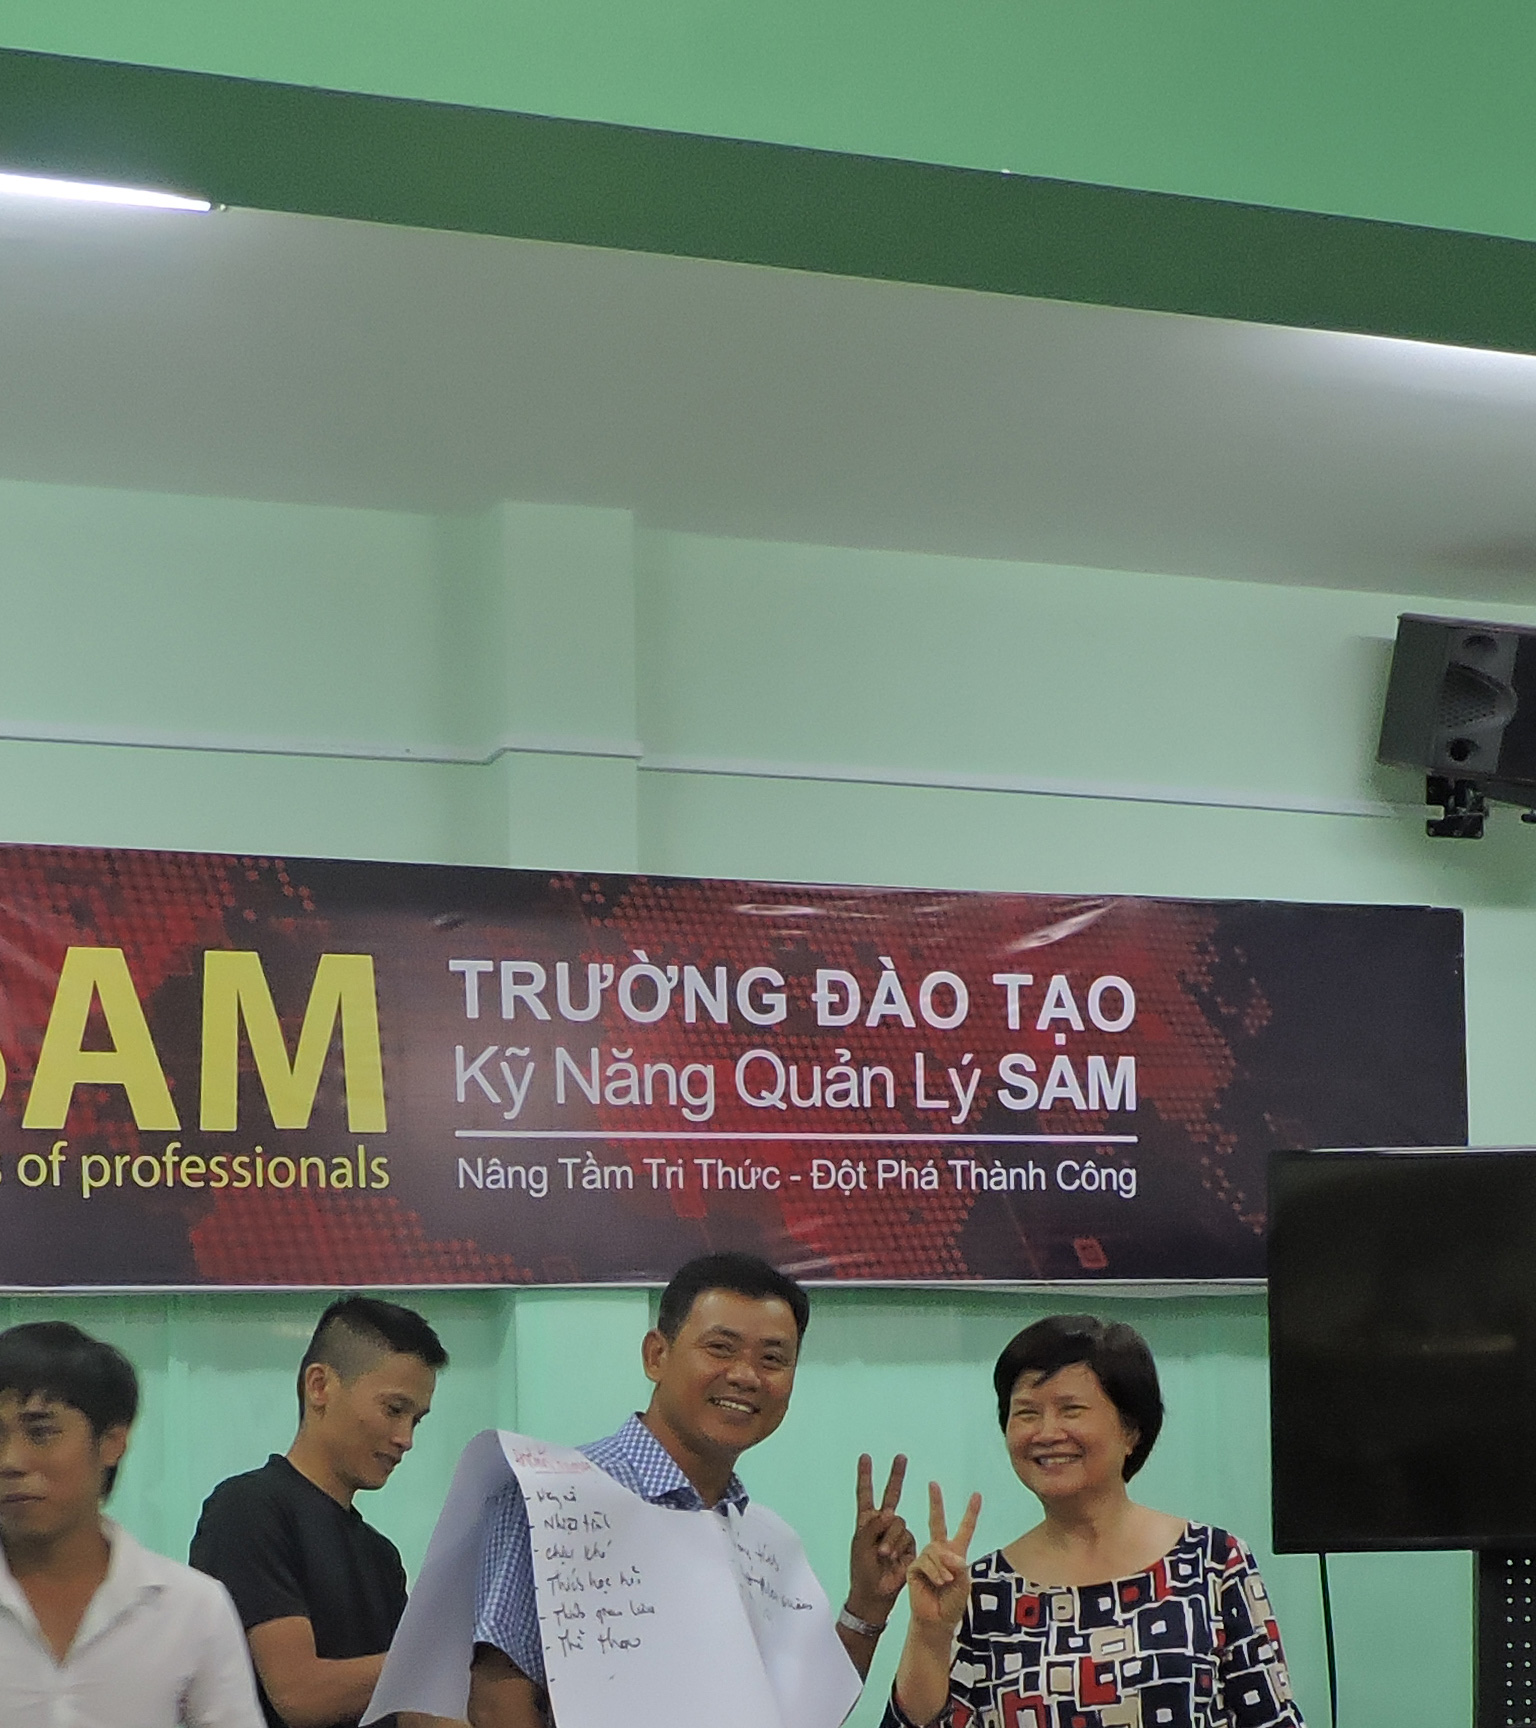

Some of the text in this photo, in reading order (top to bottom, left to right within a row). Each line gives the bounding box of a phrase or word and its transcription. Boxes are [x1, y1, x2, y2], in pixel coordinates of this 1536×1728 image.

[449, 950, 1137, 1046] TRƯỜNG ĐÀO TẠO
[455, 1045, 1137, 1125] Kỹ Năng Quản Lý SAM
[17, 1141, 68, 1188] of
[81, 1142, 390, 1199] professionals
[458, 1157, 548, 1198] Nâng
[557, 1150, 634, 1190] Tầm
[642, 1158, 684, 1189] Tri
[693, 1158, 781, 1190] Thức
[810, 1158, 867, 1196] Đột
[877, 1159, 939, 1190] Phá
[948, 1159, 1046, 1191] Thành
[1056, 1160, 1137, 1199] Công
